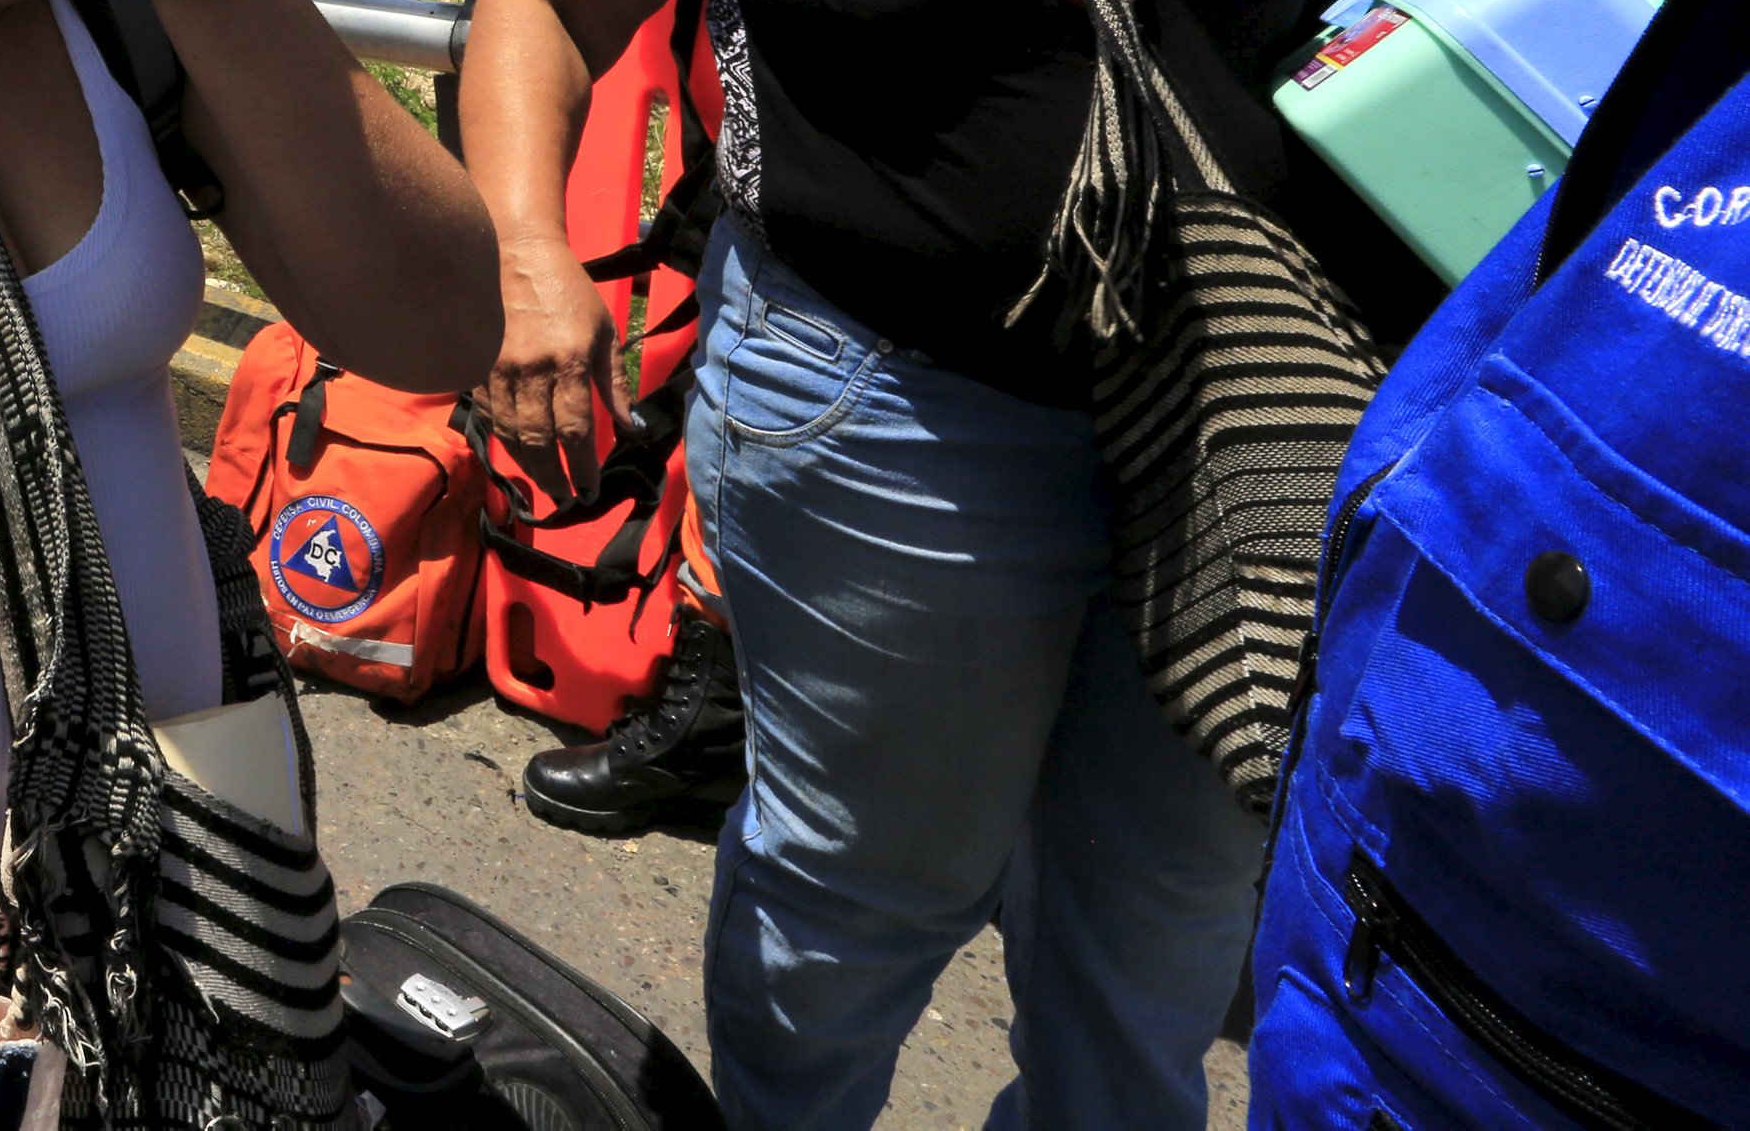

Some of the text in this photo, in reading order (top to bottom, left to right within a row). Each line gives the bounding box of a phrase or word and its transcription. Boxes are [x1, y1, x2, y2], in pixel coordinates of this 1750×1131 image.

[273, 497, 384, 574] DEFENSA CIVIL COLOMBIANA
[310, 542, 338, 565] DC
[286, 592, 298, 607] EN
